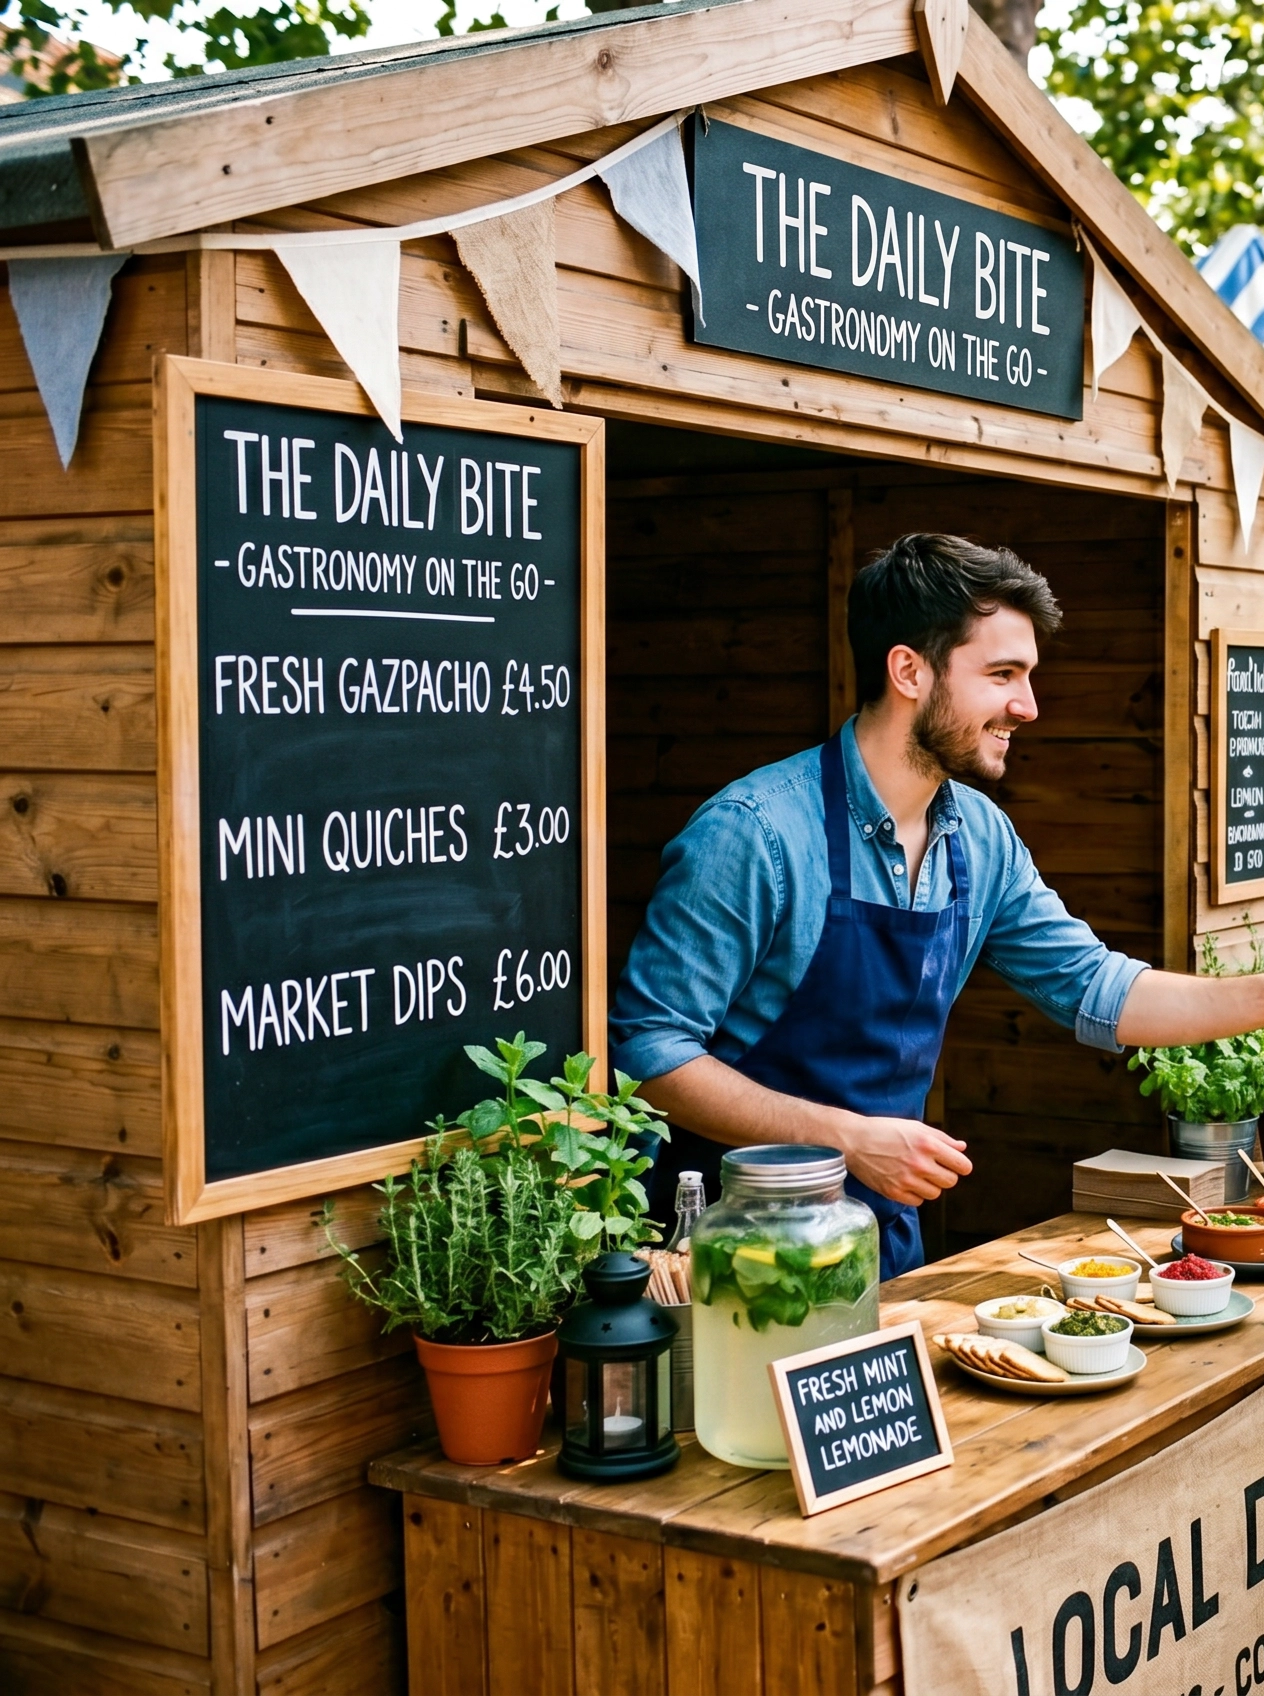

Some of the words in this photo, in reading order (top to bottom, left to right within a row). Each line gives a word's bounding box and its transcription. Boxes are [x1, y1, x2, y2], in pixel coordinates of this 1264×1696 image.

[742, 161, 833, 280] THE
[851, 194, 960, 310] DAILY
[975, 231, 1051, 336] BITE
[767, 289, 921, 363] GASTRONOMY
[928, 327, 955, 371] ON
[962, 333, 1000, 381] THE
[1006, 345, 1032, 387] GO
[223, 430, 317, 520] THE
[334, 443, 444, 531] DAILY
[460, 458, 542, 541] BITE
[237, 542, 417, 594] GASTRONOMY
[425, 556, 455, 596] ON
[462, 559, 502, 600] THE
[510, 563, 539, 600] GO
[214, 655, 325, 715] FRESH
[338, 657, 491, 714] GAZPACHO
[501, 659, 571, 716] £4.50
[218, 813, 306, 882] MINI
[322, 804, 468, 873] QUICHES
[493, 801, 570, 860] £3.00
[220, 966, 376, 1056] MARKET
[393, 956, 467, 1026] DIPS
[493, 948, 571, 1011] £6.00
[797, 1365, 859, 1406] FRESH
[862, 1349, 908, 1387] MINT
[814, 1407, 847, 1436] AND
[851, 1382, 914, 1424] LEMON
[820, 1415, 922, 1471] LEMONADE
